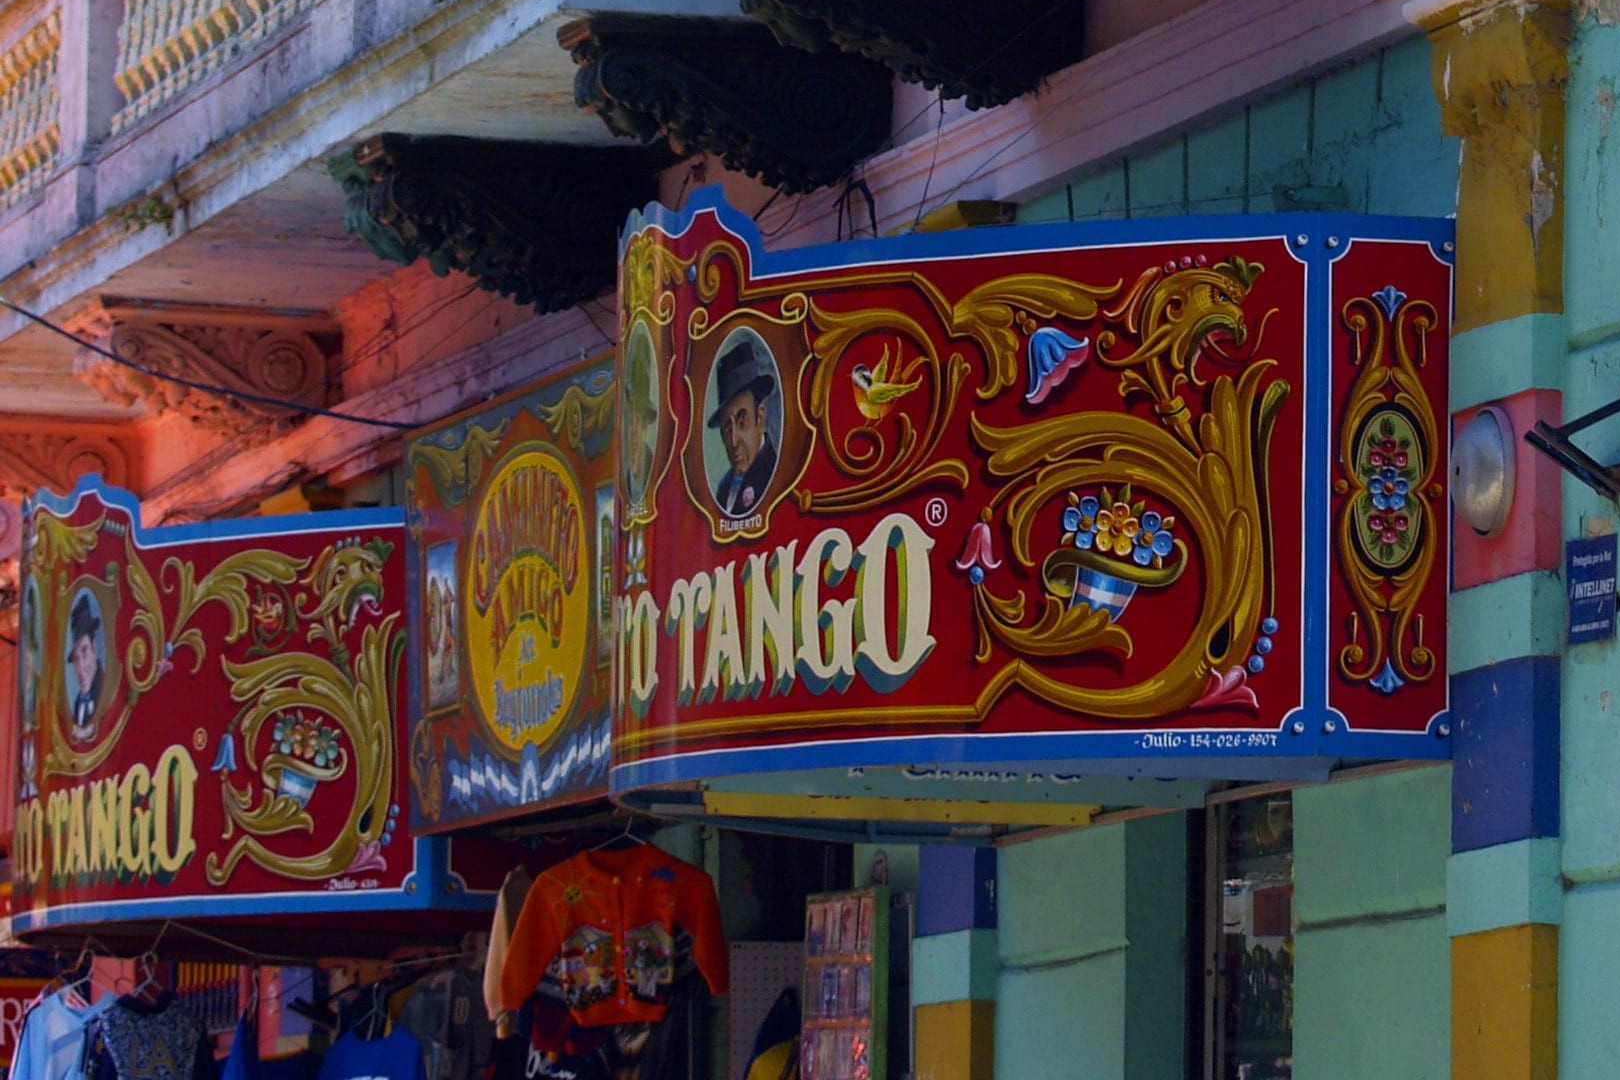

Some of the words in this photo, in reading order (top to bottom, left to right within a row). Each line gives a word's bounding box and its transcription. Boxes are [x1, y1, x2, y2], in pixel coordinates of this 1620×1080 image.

[719, 514, 762, 533] FILIBERTO
[668, 512, 938, 695] TANGO
[1190, 733, 1277, 748] 154-026-9907
[47, 744, 199, 877] TANGO
